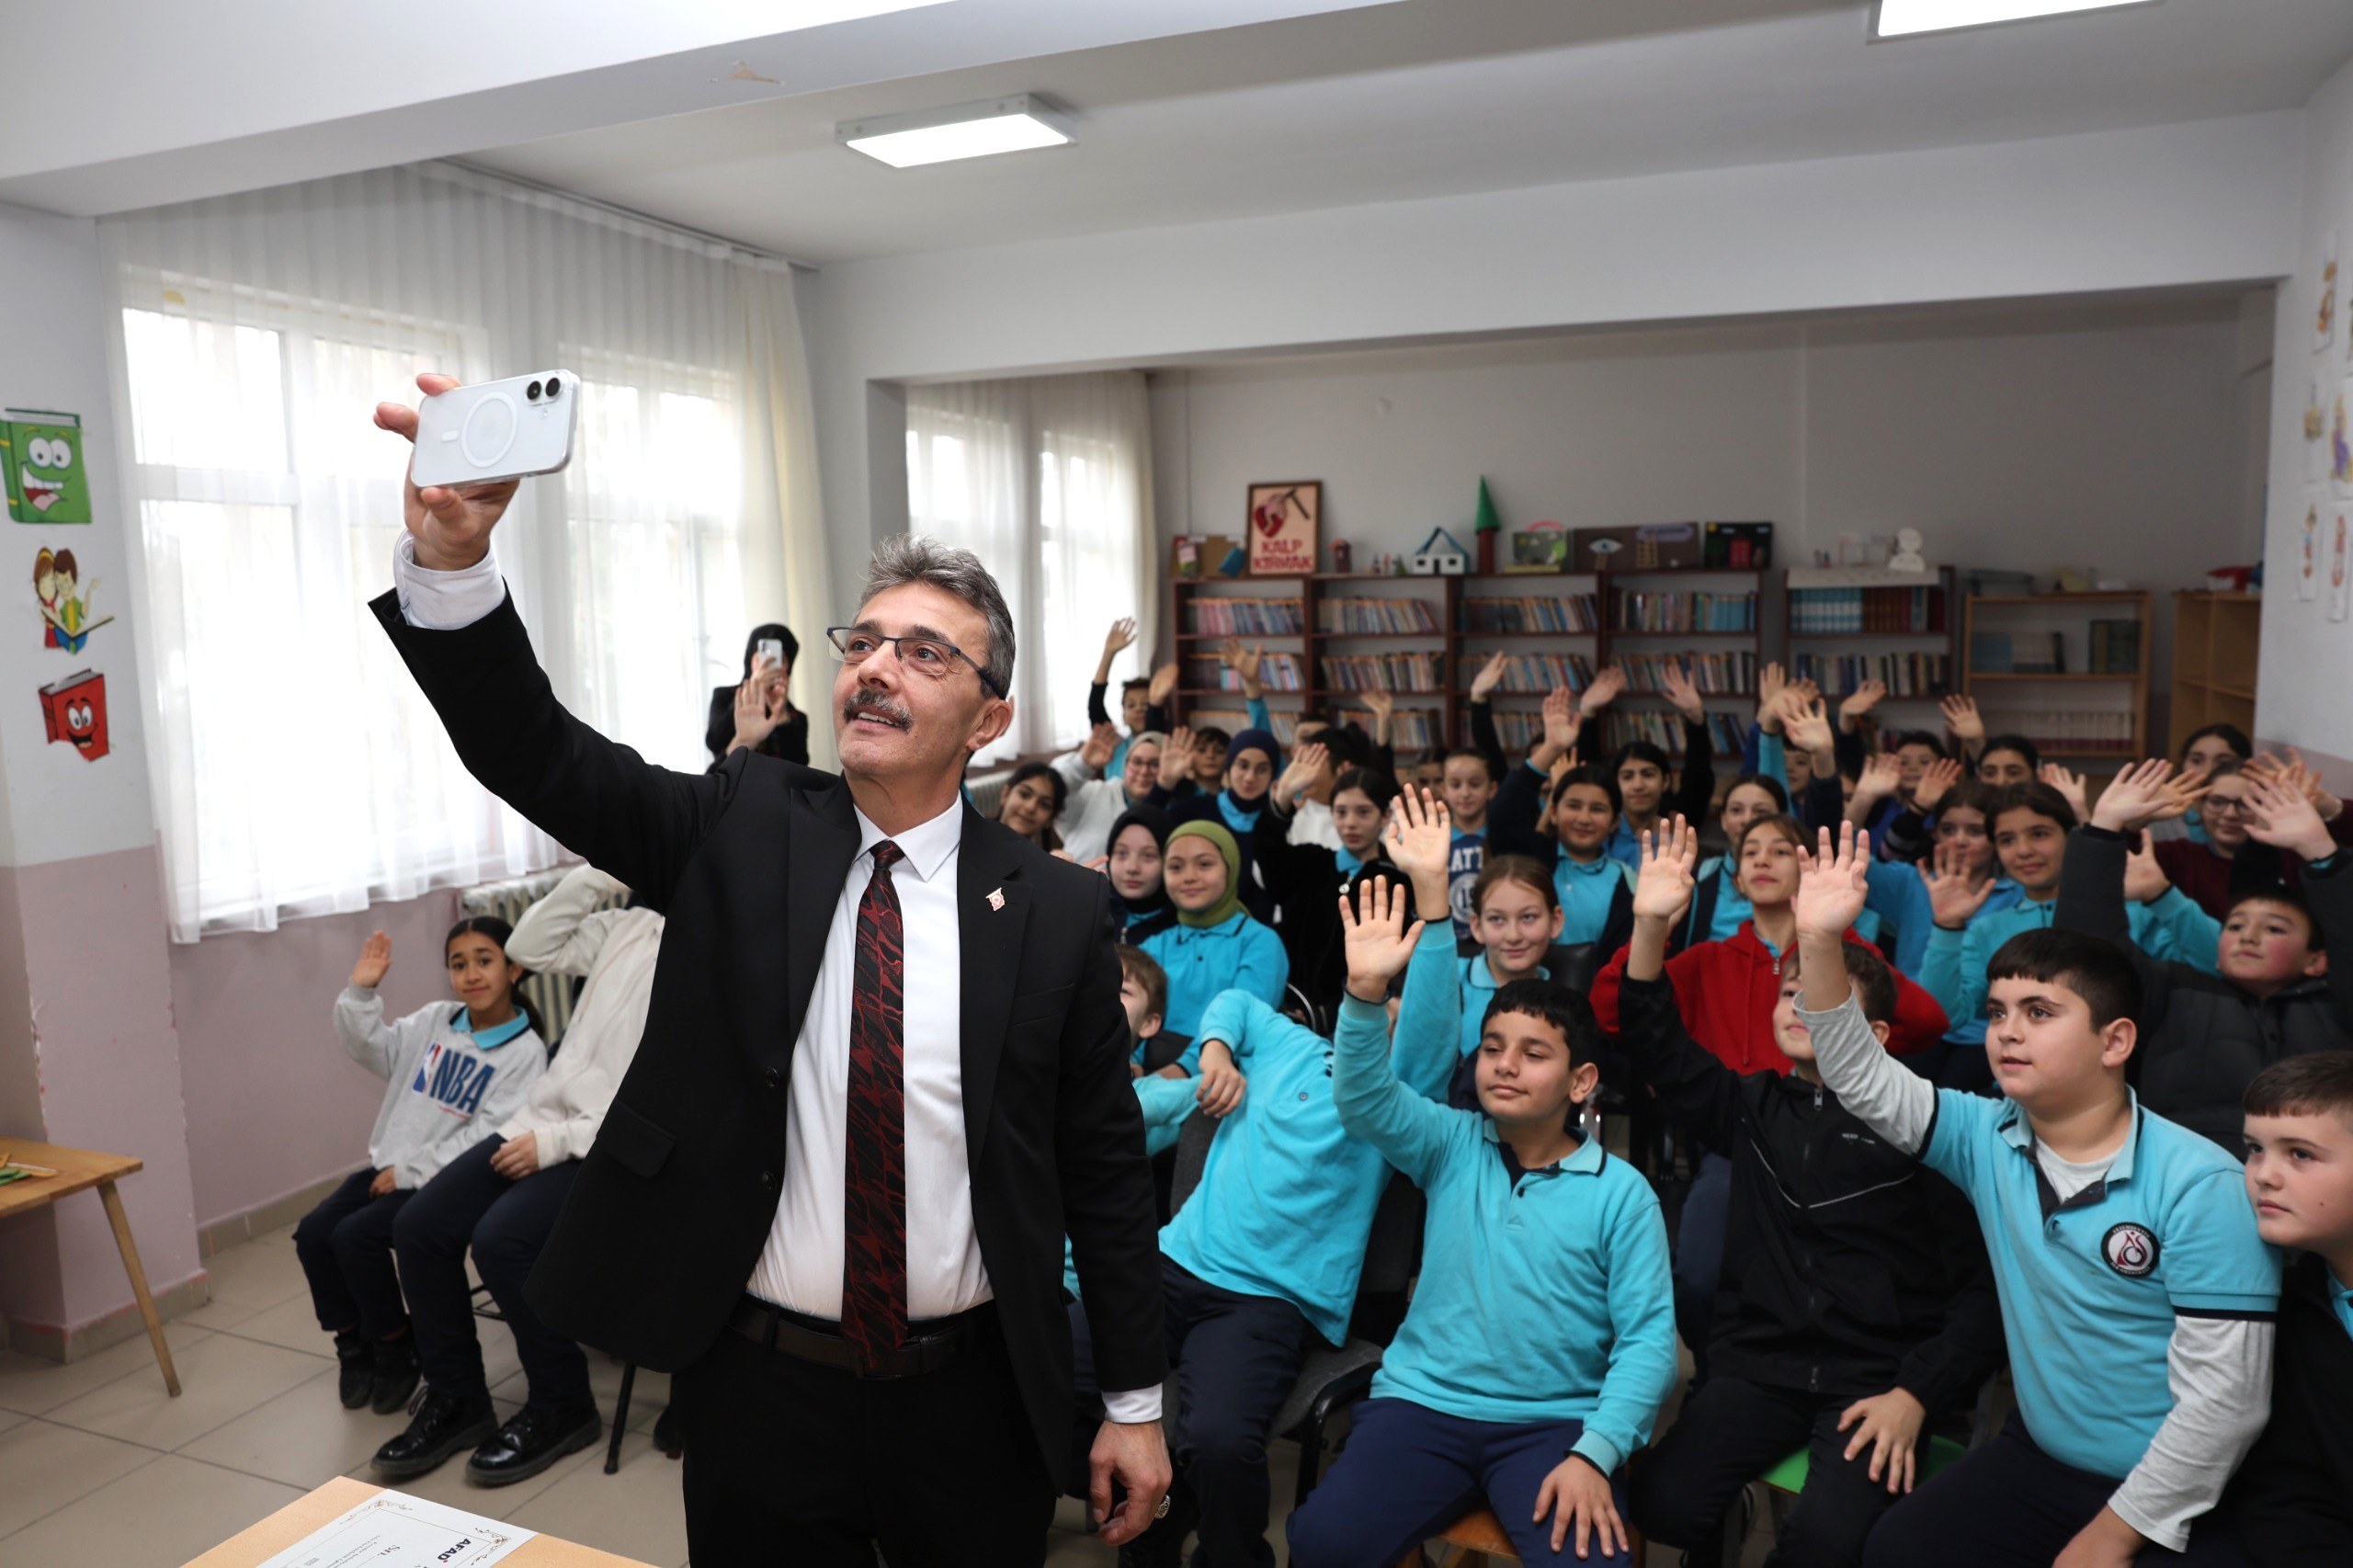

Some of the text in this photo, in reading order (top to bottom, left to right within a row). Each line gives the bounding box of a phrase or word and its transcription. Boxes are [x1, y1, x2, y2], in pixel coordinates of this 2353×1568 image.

[1447, 846, 1483, 872] ATT
[429, 1048, 495, 1114] NBA
[437, 1538, 472, 1562] AFAD
